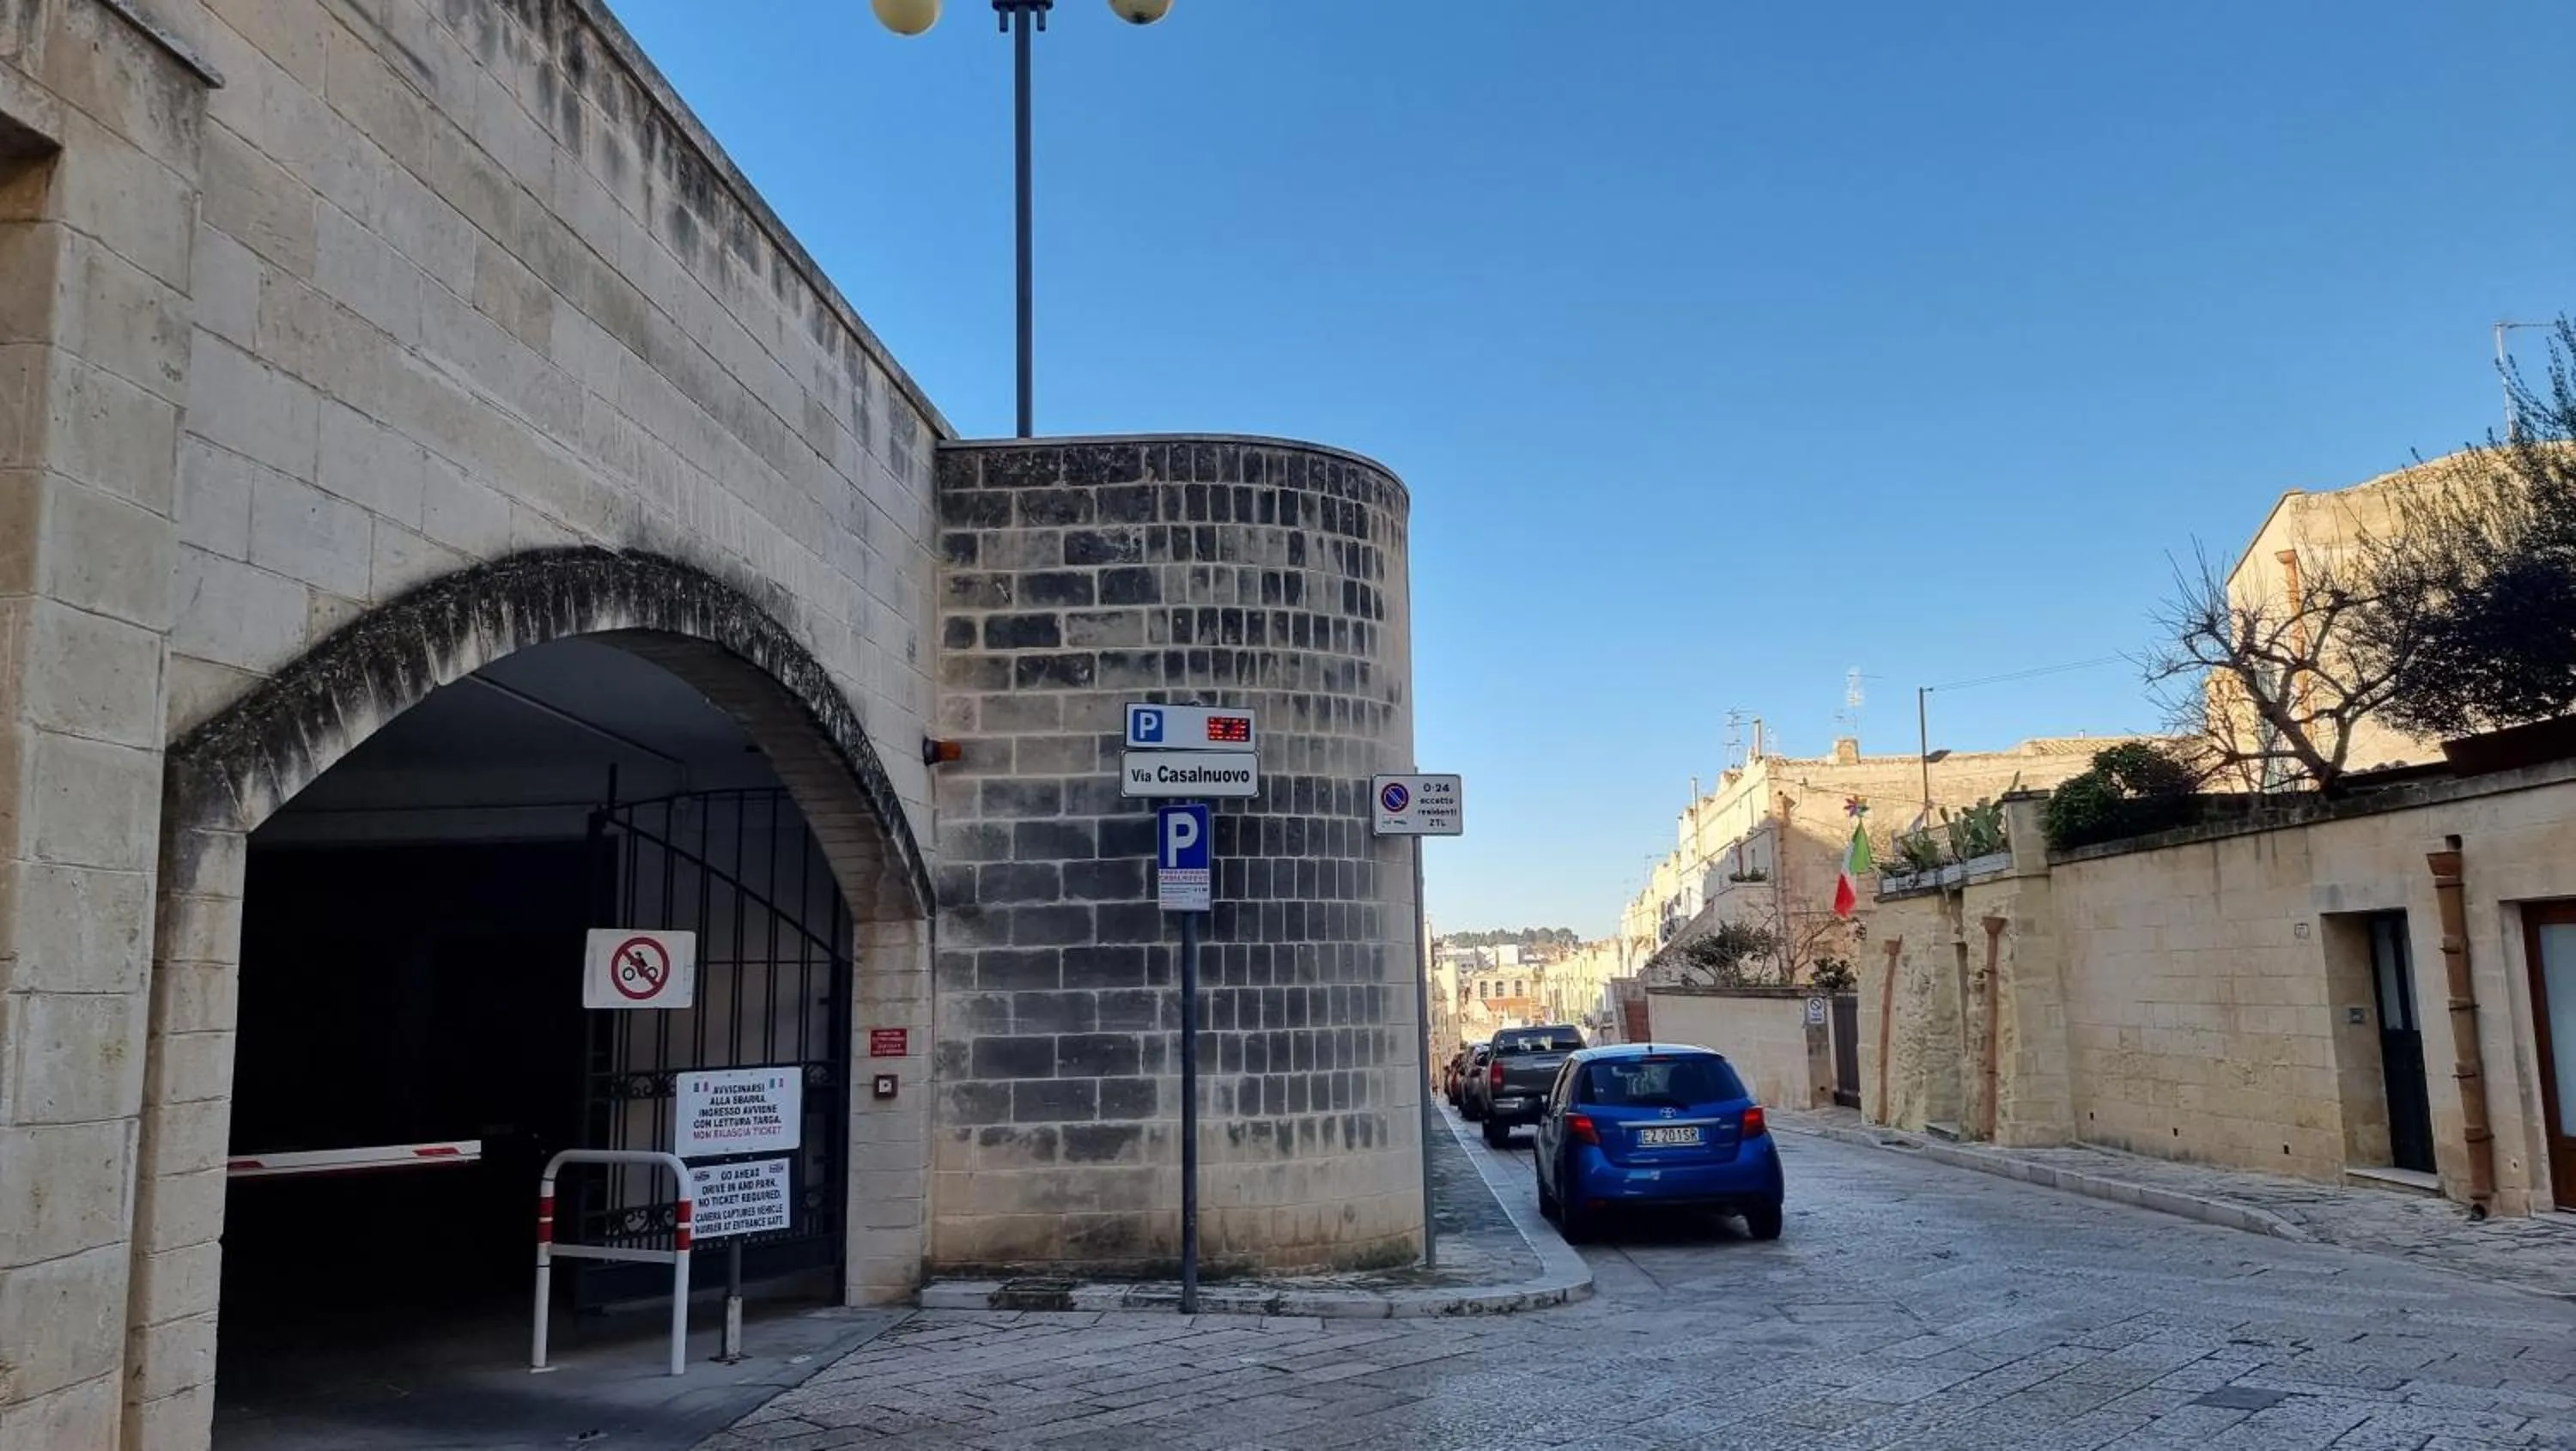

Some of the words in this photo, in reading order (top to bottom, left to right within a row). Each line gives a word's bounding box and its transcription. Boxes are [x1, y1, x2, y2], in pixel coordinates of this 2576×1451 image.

[1139, 713, 1157, 738] P
[1131, 768, 1151, 782] Via
[1157, 766, 1249, 783] Casalnuovo
[1418, 807, 1456, 816] residenti
[1429, 818, 1446, 827] ZTL
[1168, 812, 1198, 867] P
[713, 1083, 765, 1095] AVVICINARSI
[709, 1096, 731, 1106] ALLA
[699, 1106, 741, 1117] INGRESSO
[743, 1104, 778, 1114] AVVIENE
[694, 1119, 711, 1128] CON
[714, 1117, 750, 1127] LETTURA
[694, 1129, 712, 1139] NON
[713, 1127, 750, 1138] RILASCIA
[752, 1126, 782, 1136] TICKET
[721, 1170, 732, 1181] GO
[734, 1167, 760, 1179] AHEAD
[702, 1183, 726, 1195] DRIVE
[727, 1182, 736, 1193] IN
[738, 1180, 754, 1191] AND
[698, 1198, 710, 1207] NO
[711, 1193, 739, 1206] TICKET
[696, 1211, 721, 1223] CAMERA
[723, 1206, 756, 1219] CAPTURES
[756, 1203, 783, 1215] VEHICLE
[724, 1220, 732, 1231] AT
[732, 1217, 766, 1229] ENTRANCE
[767, 1215, 783, 1225] GATE
